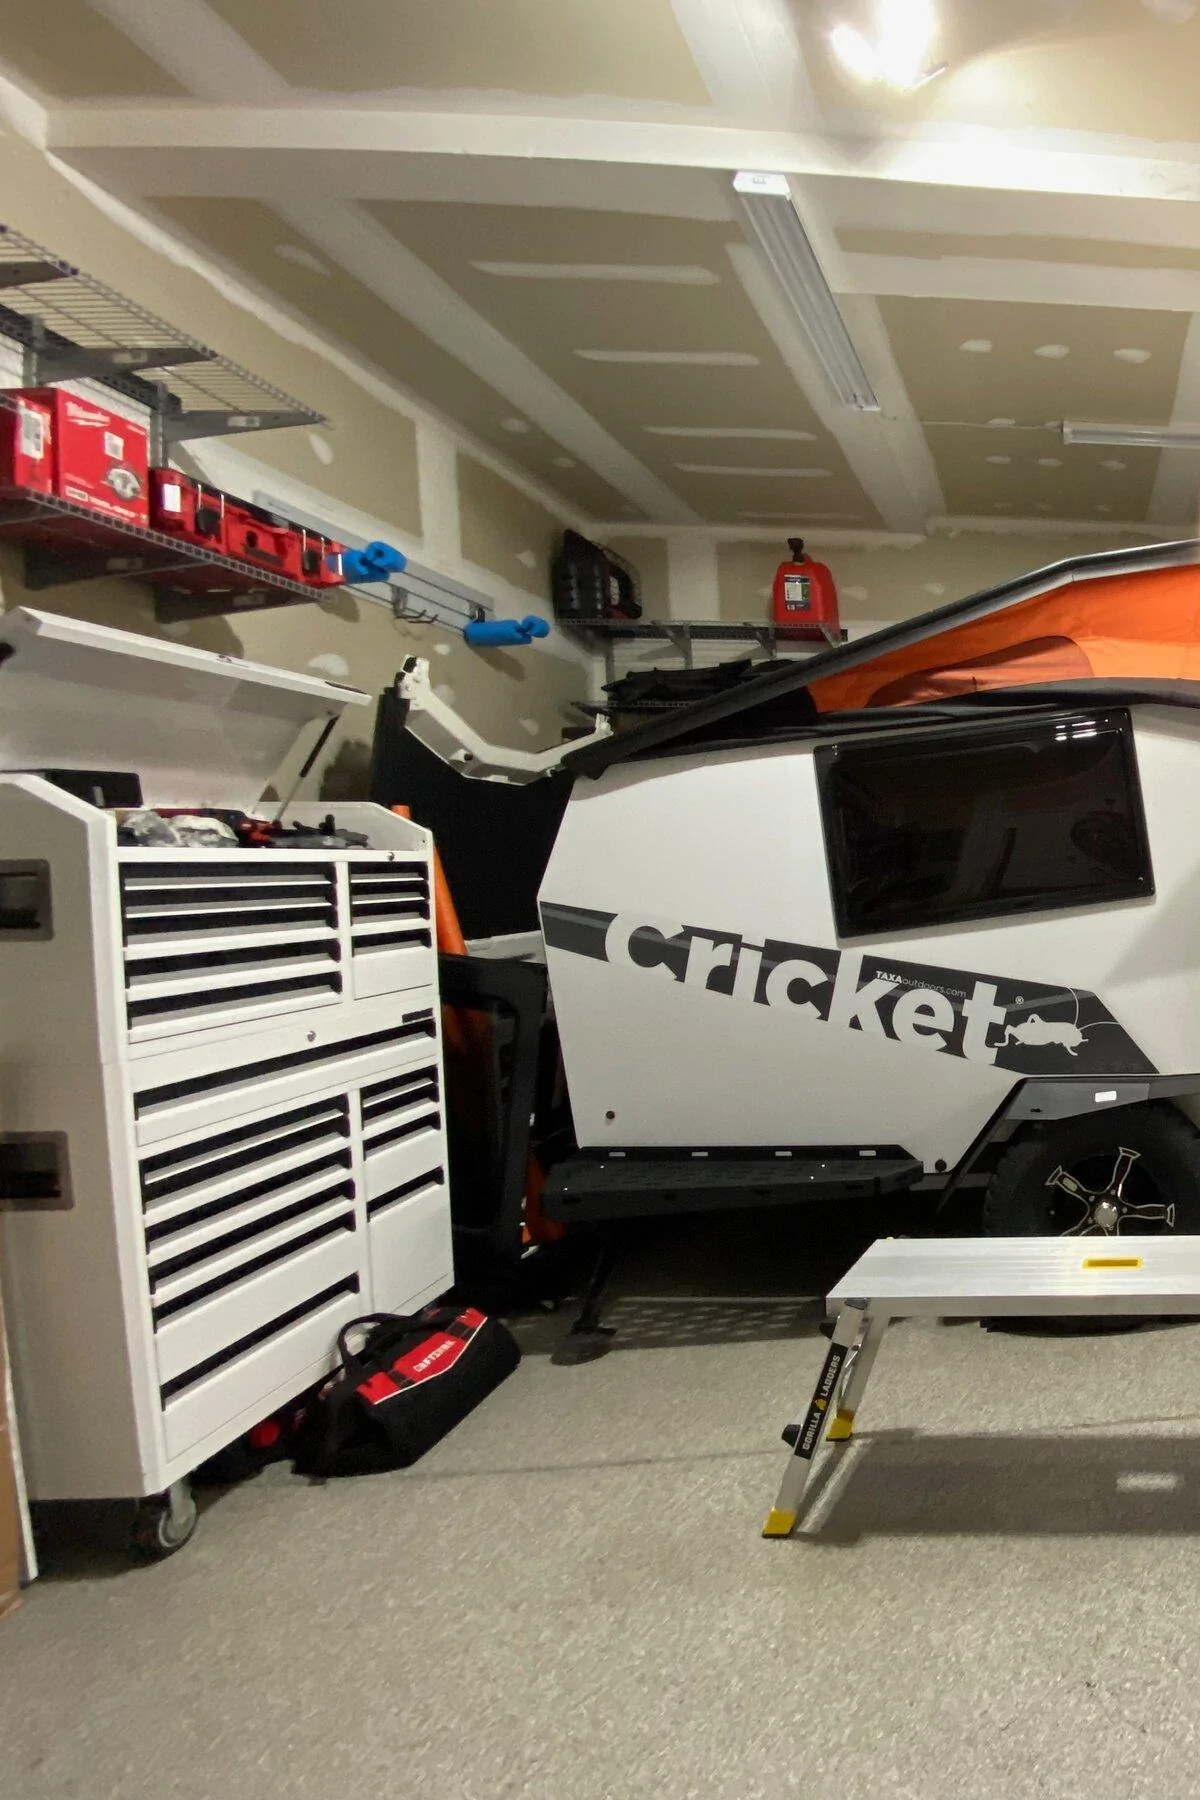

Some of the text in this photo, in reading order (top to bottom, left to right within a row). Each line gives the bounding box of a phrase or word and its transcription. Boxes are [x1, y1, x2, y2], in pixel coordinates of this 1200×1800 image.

[604, 912, 1008, 1064] Cricket
[875, 970, 966, 998] TAXAoutdoors.com
[802, 1355, 840, 1450] GORILLA LADDERS
